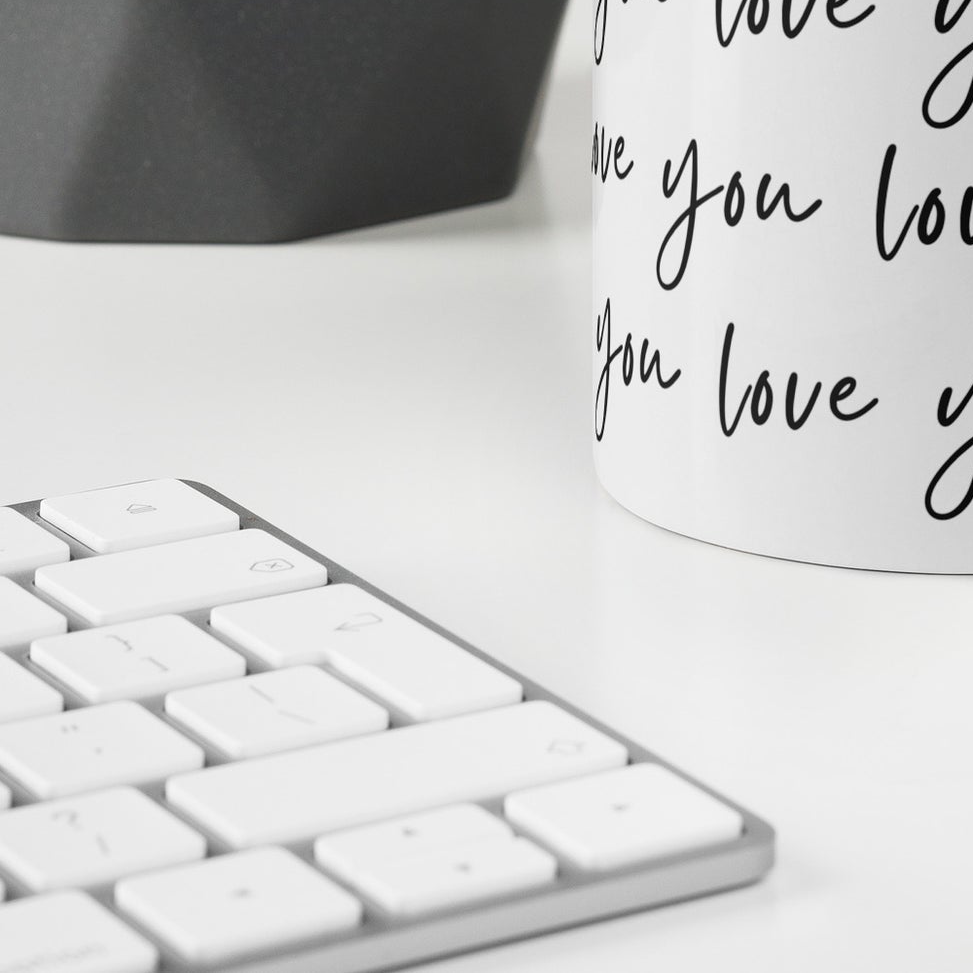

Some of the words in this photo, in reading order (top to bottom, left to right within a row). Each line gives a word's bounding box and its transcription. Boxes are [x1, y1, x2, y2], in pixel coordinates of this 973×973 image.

[592, 121, 634, 184] ove
[657, 140, 823, 291] you
[595, 297, 682, 442] you
[719, 323, 879, 437] love
